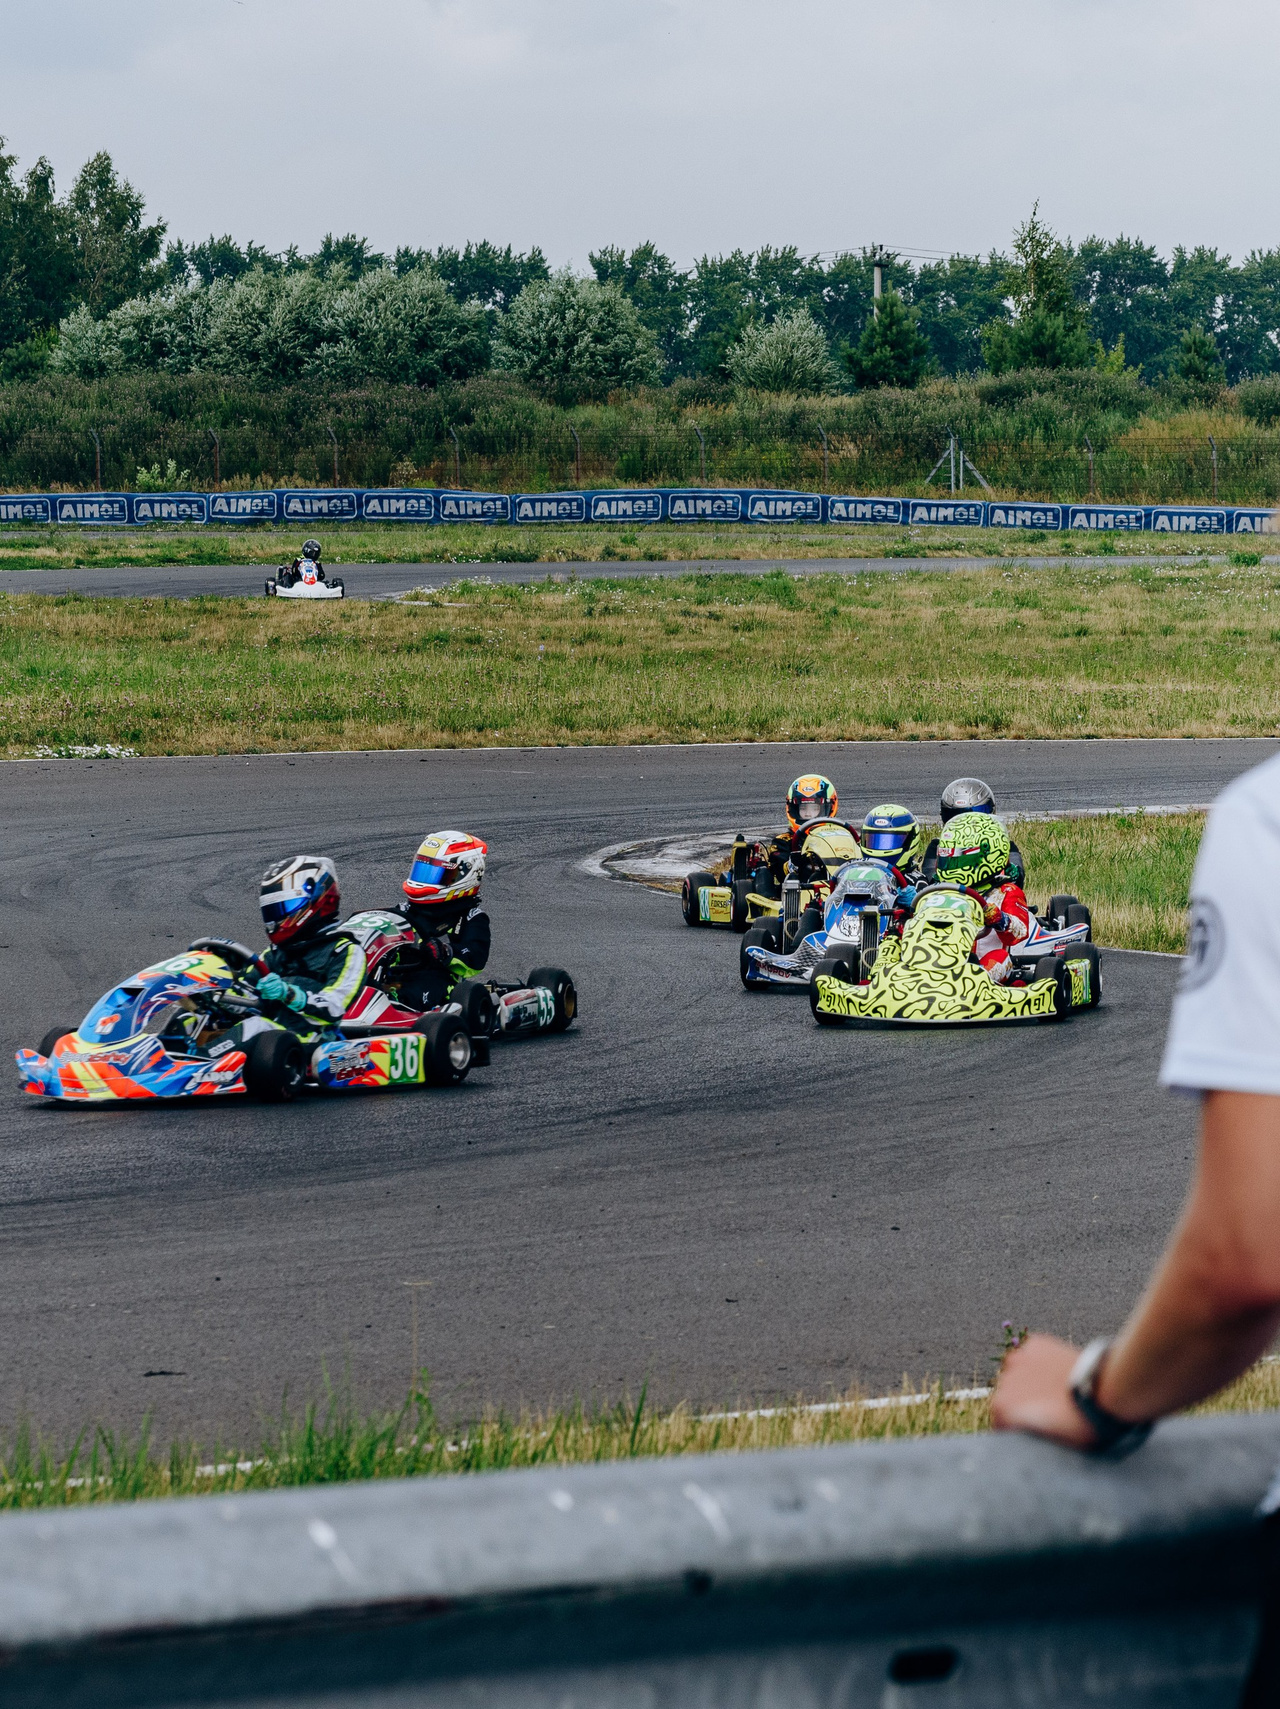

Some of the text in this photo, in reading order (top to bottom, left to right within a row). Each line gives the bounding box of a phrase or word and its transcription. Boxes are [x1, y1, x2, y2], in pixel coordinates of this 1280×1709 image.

[0, 504, 47, 519] IMOL
[61, 504, 128, 519] AIMOL
[138, 503, 203, 518] AIMOL
[213, 498, 274, 513] AIMOL
[287, 498, 353, 514] AIMOL
[366, 498, 430, 514] AIMOL
[444, 500, 507, 516] AIMOL
[519, 501, 581, 517] AIMOL
[595, 500, 658, 515] AIMOL
[672, 500, 738, 515] AIMOL
[751, 500, 817, 516] AIMOL
[832, 503, 898, 520] AIMOL
[913, 506, 979, 522] AIMOL
[992, 509, 1058, 527] AIMOL
[1072, 512, 1140, 529] AIMOL
[1155, 514, 1223, 532] AIMOL
[857, 866, 873, 879] 7
[926, 894, 968, 909] 97
[538, 989, 555, 1027] 55
[390, 1035, 419, 1079] 36
